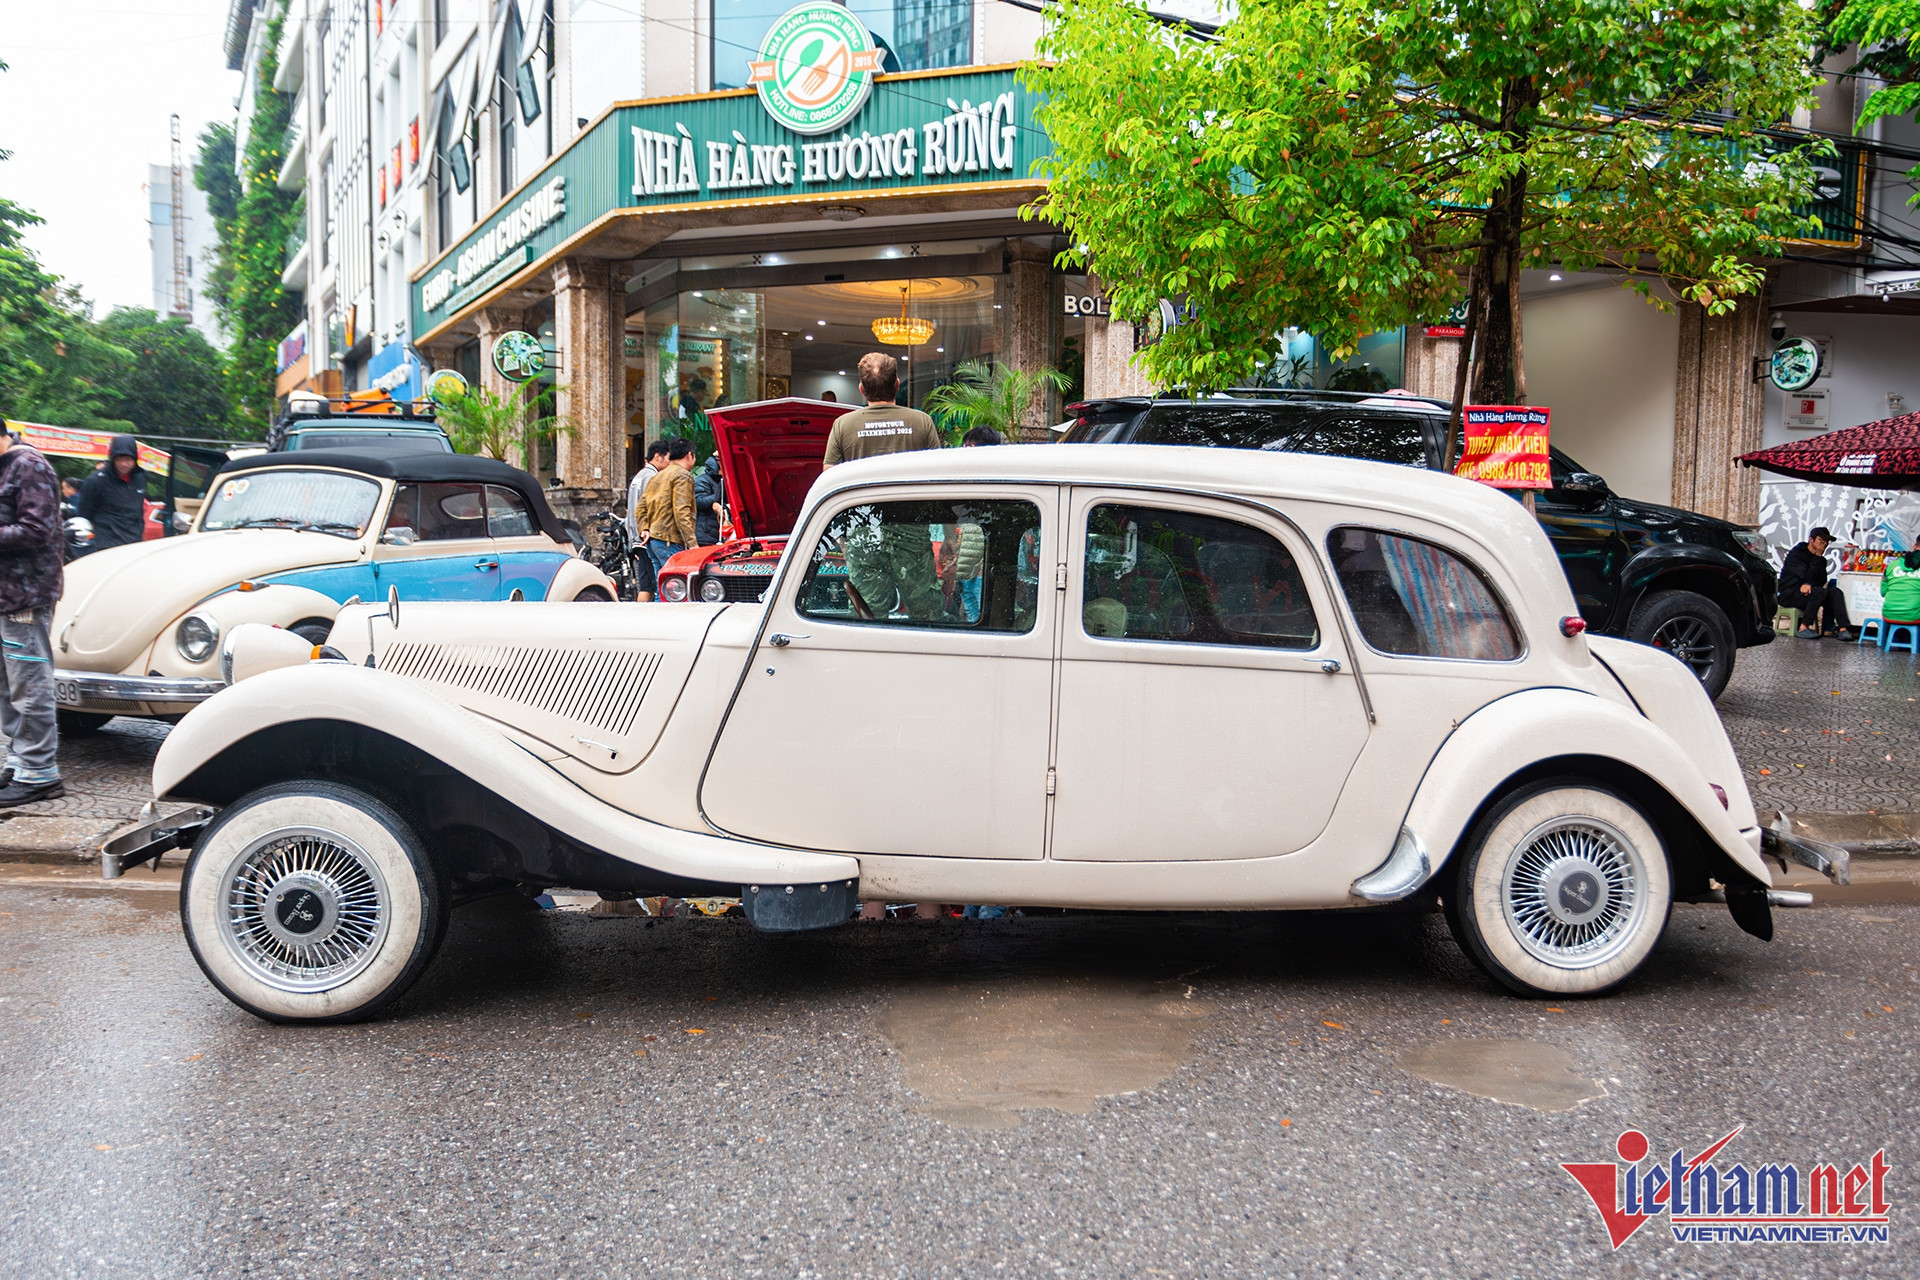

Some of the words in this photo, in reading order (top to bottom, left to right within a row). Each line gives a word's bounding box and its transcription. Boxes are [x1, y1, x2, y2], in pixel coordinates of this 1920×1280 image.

[854, 55, 872, 67] 2015
[769, 88, 808, 121] HOTLINE:
[631, 121, 700, 196] NHÀ
[706, 129, 797, 189] HÀNG
[801, 127, 918, 182] HƯƠNG
[922, 91, 1017, 175] RỪNG
[457, 229, 496, 286] ASIAN
[496, 175, 566, 255] CUISINE
[1063, 295, 1108, 315] BOL
[864, 420, 904, 429] MOTORTOUR
[1469, 413, 1484, 422] Nhà
[1486, 413, 1504, 423] Hàng
[1467, 428, 1494, 455] TUYỂN
[1492, 431, 1521, 454] NHÂN
[1524, 431, 1547, 455] VIÊN
[1478, 461, 1548, 480] 0988.410.792
